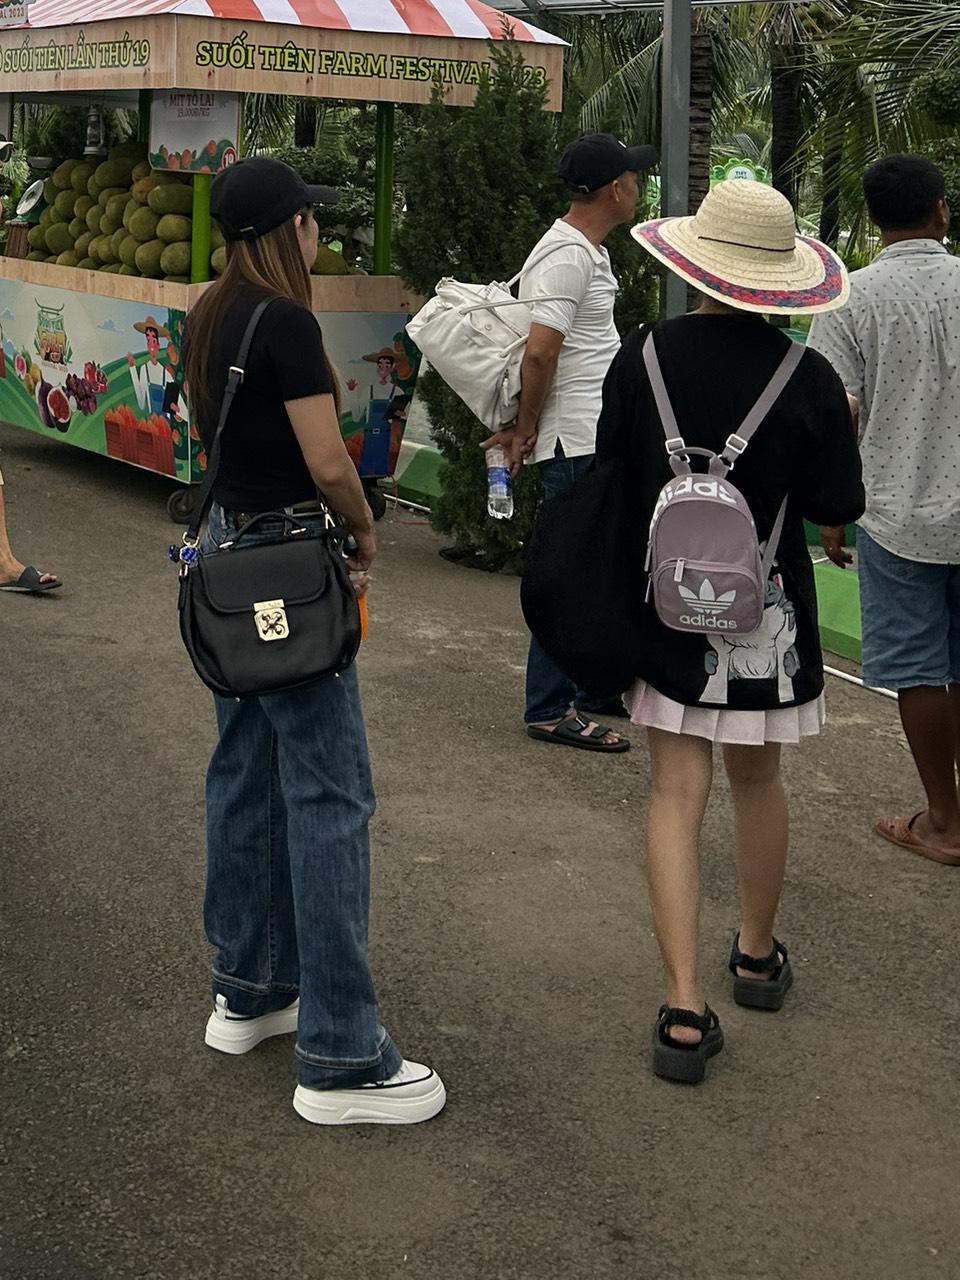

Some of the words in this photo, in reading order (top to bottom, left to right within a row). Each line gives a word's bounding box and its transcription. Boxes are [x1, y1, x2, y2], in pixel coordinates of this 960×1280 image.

[9, 7, 25, 19] 2023
[3, 35, 35, 73] SUỐI
[35, 39, 67, 70] TIÊN
[67, 30, 100, 69] LẦN
[99, 31, 134, 67] THỨ
[133, 39, 151, 66] 19
[195, 31, 256, 69] SUỐI
[258, 40, 314, 73] TIÊN
[319, 50, 388, 79] FARM
[390, 55, 495, 86] FESTIVAL
[679, 614, 737, 629] adidas
